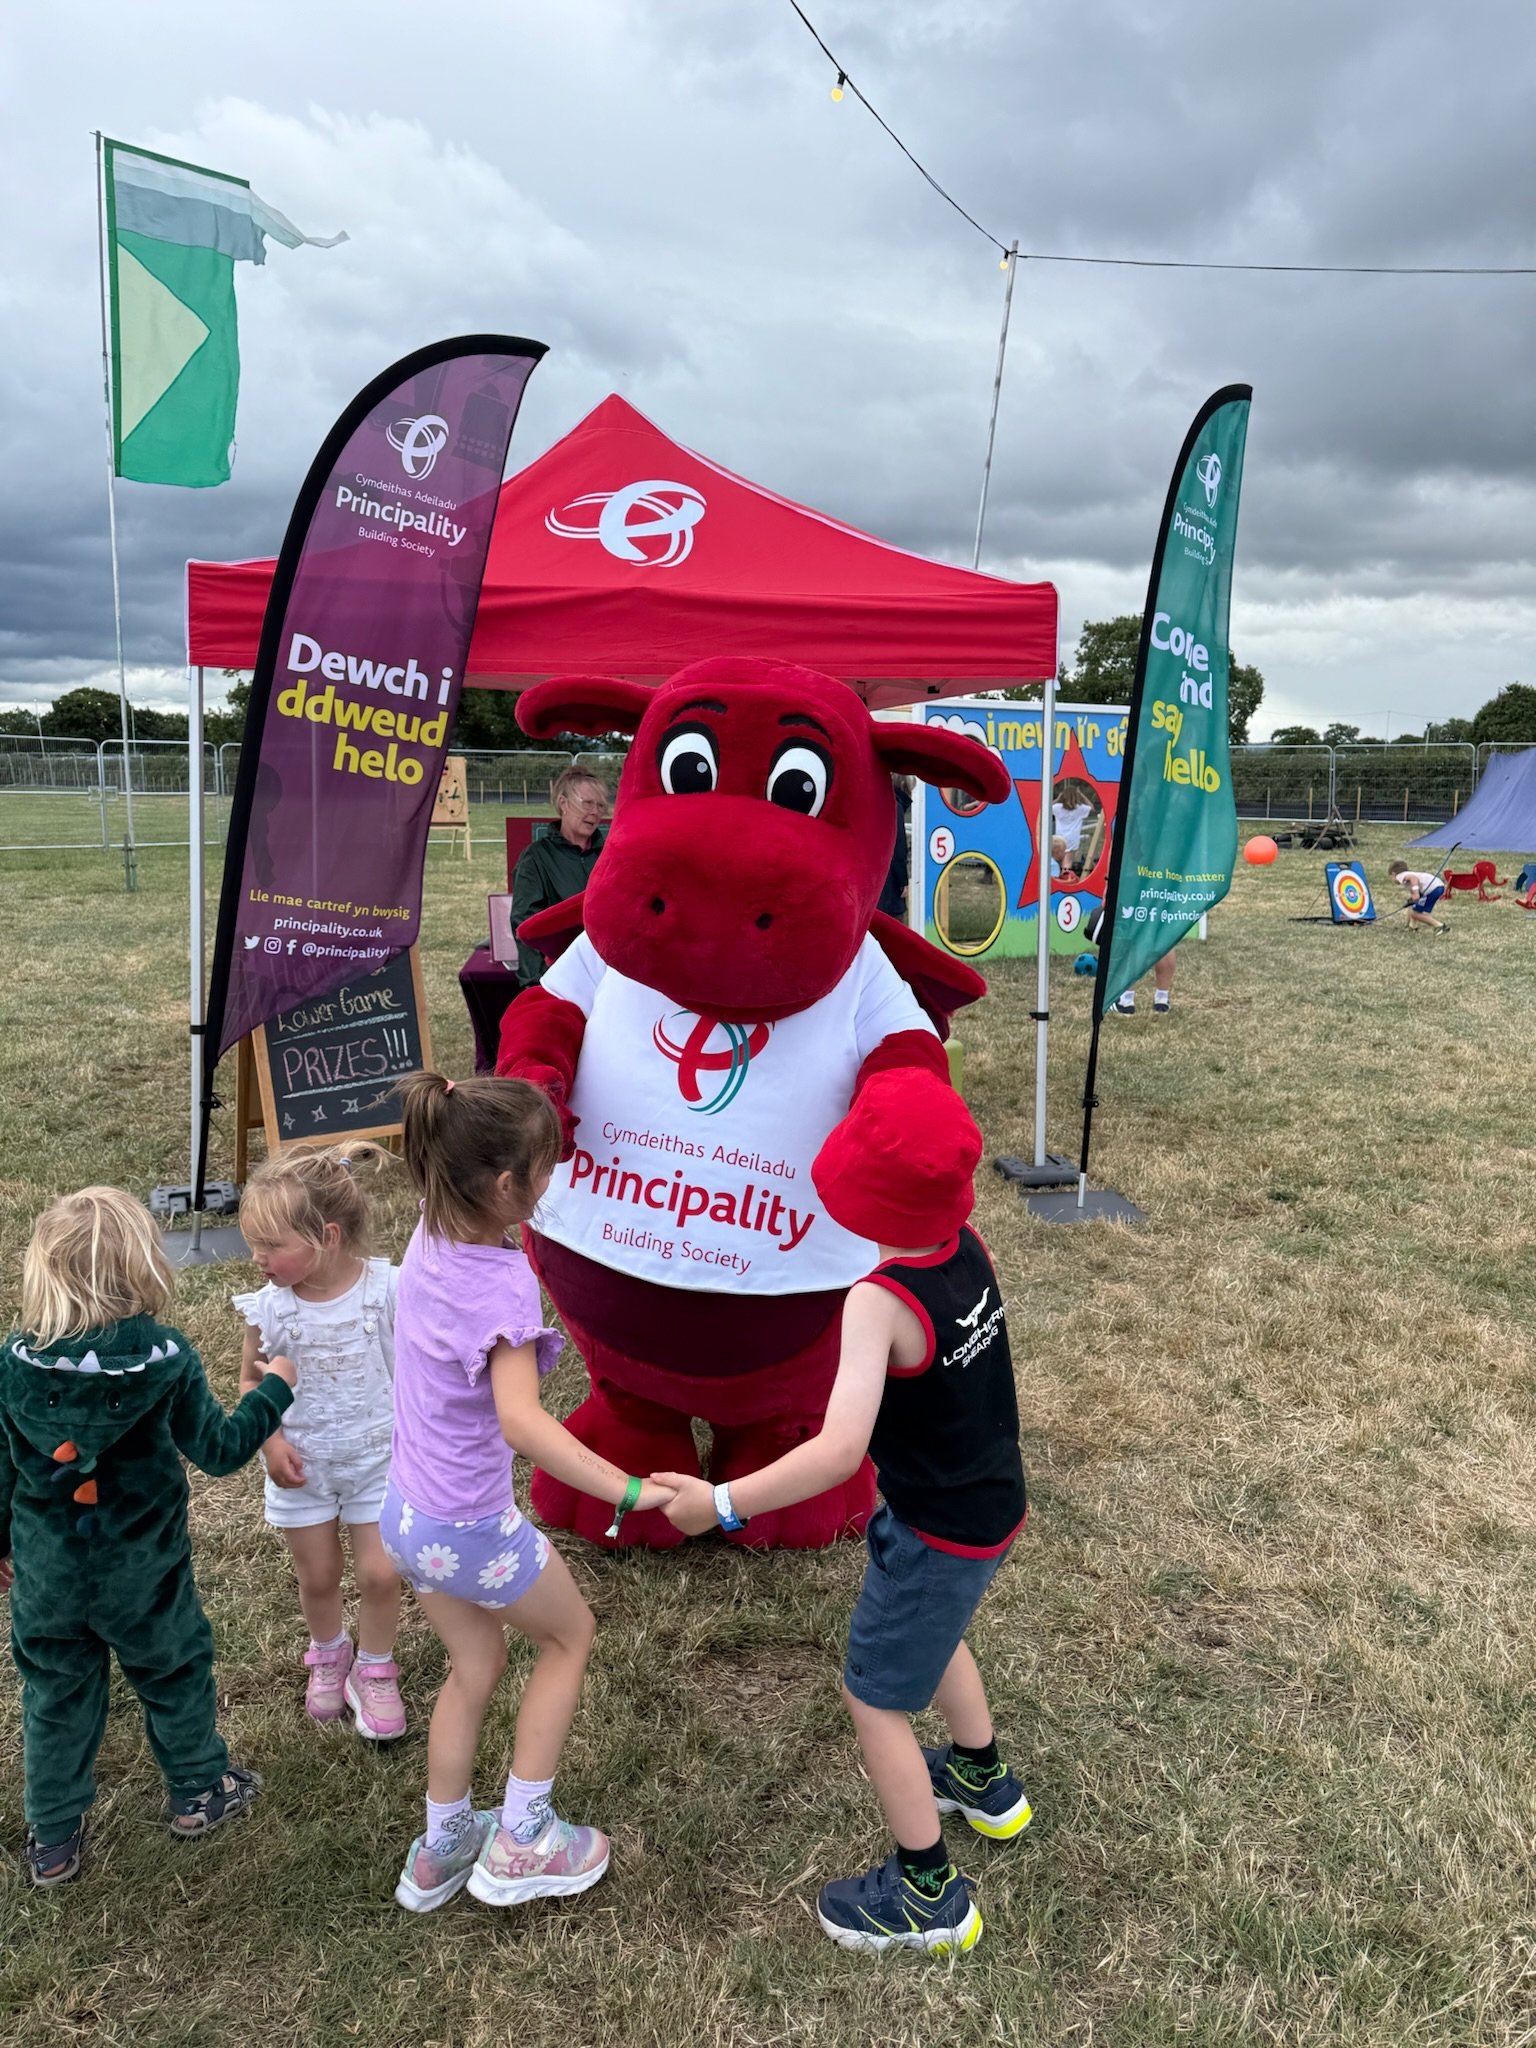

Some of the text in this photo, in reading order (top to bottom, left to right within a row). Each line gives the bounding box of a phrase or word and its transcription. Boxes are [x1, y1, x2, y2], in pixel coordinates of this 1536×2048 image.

[335, 485, 467, 546] Principality
[355, 473, 457, 511] Cymdeithas Adeiladu
[358, 526, 436, 558] Building Society
[287, 633, 453, 705] Dewch i
[277, 679, 449, 748] ddweud
[1151, 700, 1184, 748] say
[333, 732, 424, 785] helo
[1163, 740, 1221, 793] hello
[936, 836, 947, 858] 5
[1185, 873, 1225, 882] matters
[250, 889, 411, 920] Lle mae cartref yn bwysig
[273, 917, 383, 938] principality.co.uk
[1063, 902, 1073, 925] 3
[278, 986, 403, 1032] Lower Game
[282, 1027, 414, 1091] PRIZES!!!
[602, 1122, 796, 1180] Cymdeithas Adeiladu
[569, 1149, 816, 1251] Principality
[602, 1223, 752, 1275] Building Society
